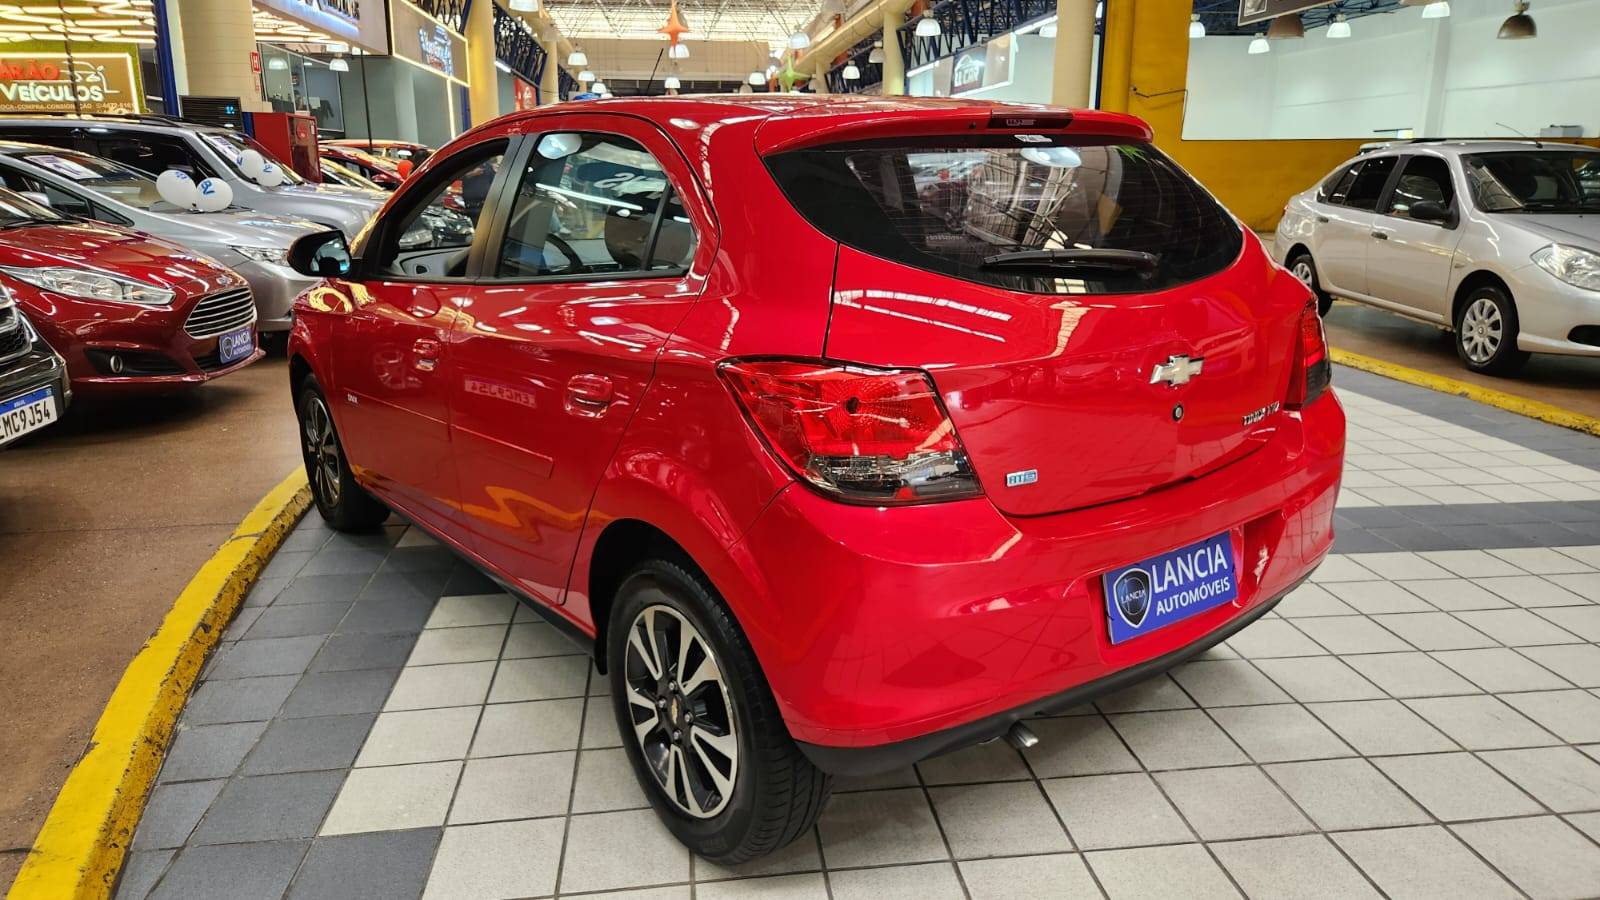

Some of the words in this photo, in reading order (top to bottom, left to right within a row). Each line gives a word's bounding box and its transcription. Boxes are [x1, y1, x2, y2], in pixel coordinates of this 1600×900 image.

[0, 81, 104, 102] VEÍCULOS
[1151, 543, 1228, 594] LANCIA
[1121, 589, 1146, 604] LANCIA
[1156, 576, 1231, 616] AUTOMÓVEIS
